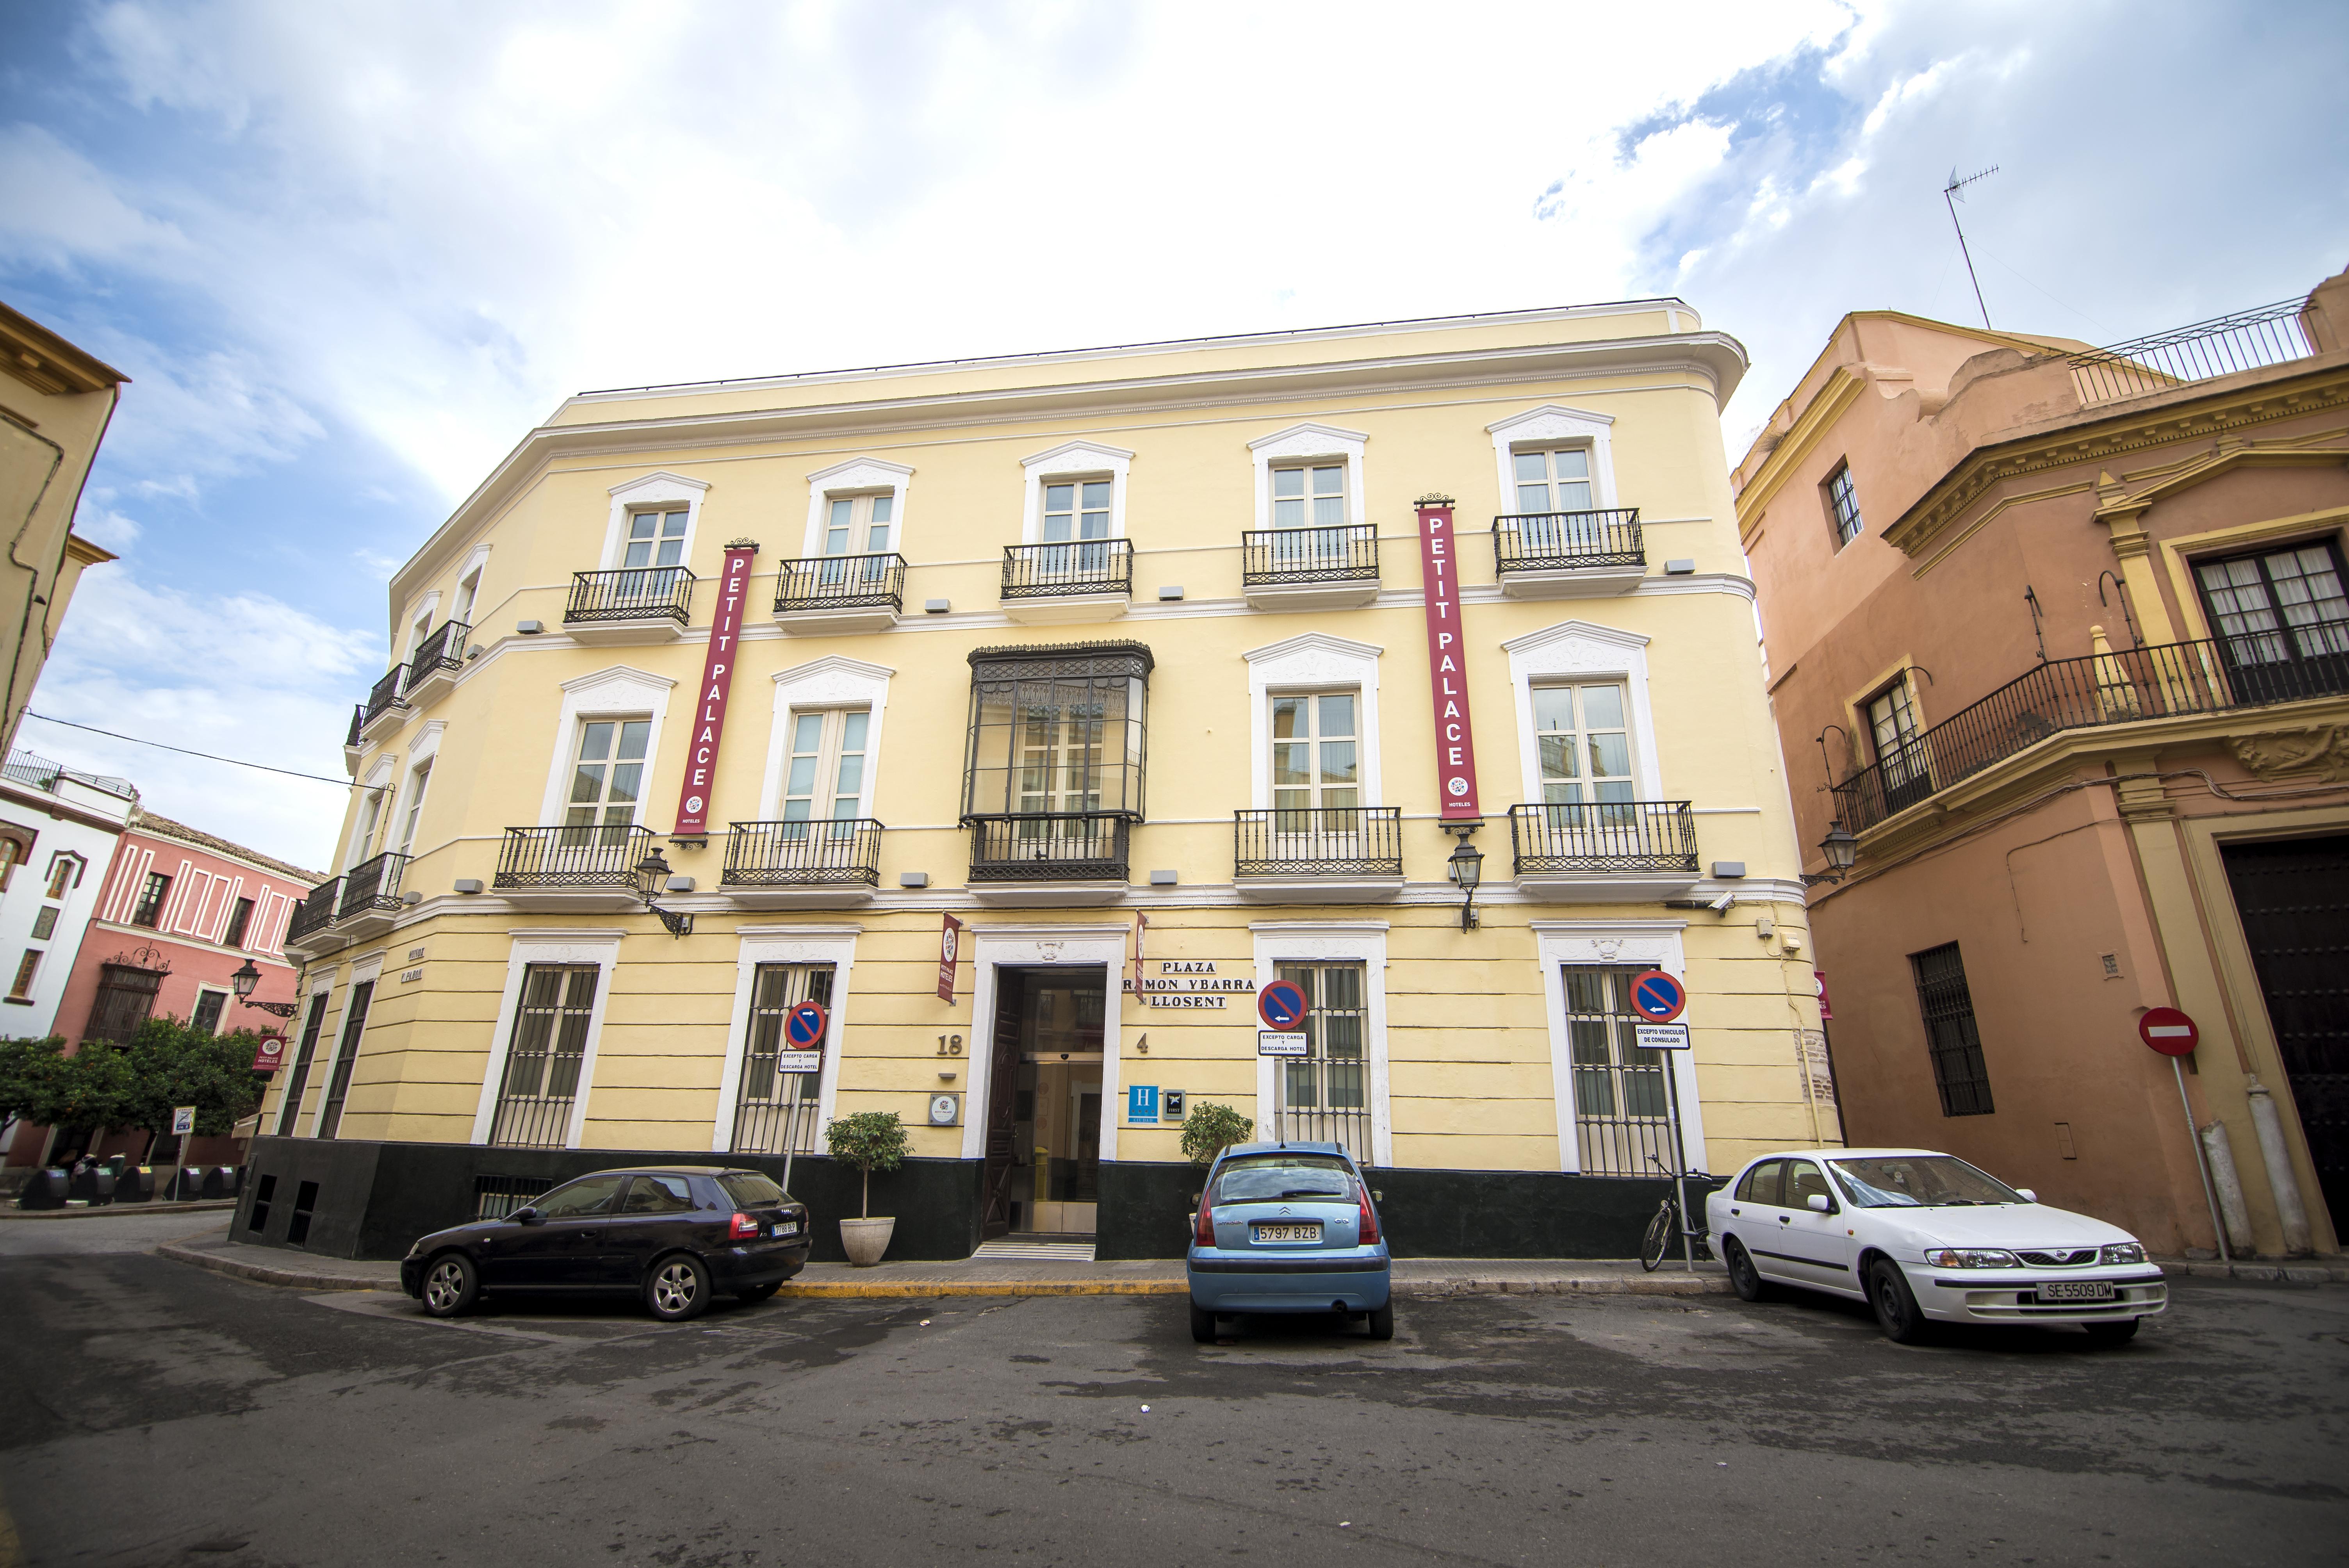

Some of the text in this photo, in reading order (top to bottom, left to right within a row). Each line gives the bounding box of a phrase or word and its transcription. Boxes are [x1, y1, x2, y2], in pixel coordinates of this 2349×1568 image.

[1429, 518, 1463, 765] PETIT PALACE
[693, 559, 744, 786] PETIT PALACE
[1163, 962, 1215, 972] PLAZA
[940, 970, 953, 983] HOTELES
[1123, 979, 1178, 989] RMON
[1188, 979, 1255, 990] YBARRA
[1151, 996, 1225, 1007] LLOSENT
[937, 1034, 962, 1055] 18
[1137, 1033, 1148, 1053] 4
[1136, 1089, 1150, 1106] H
[776, 1224, 787, 1234] 7788
[1260, 1227, 1317, 1239] 5797 BZB
[2096, 1283, 2112, 1297] DM
